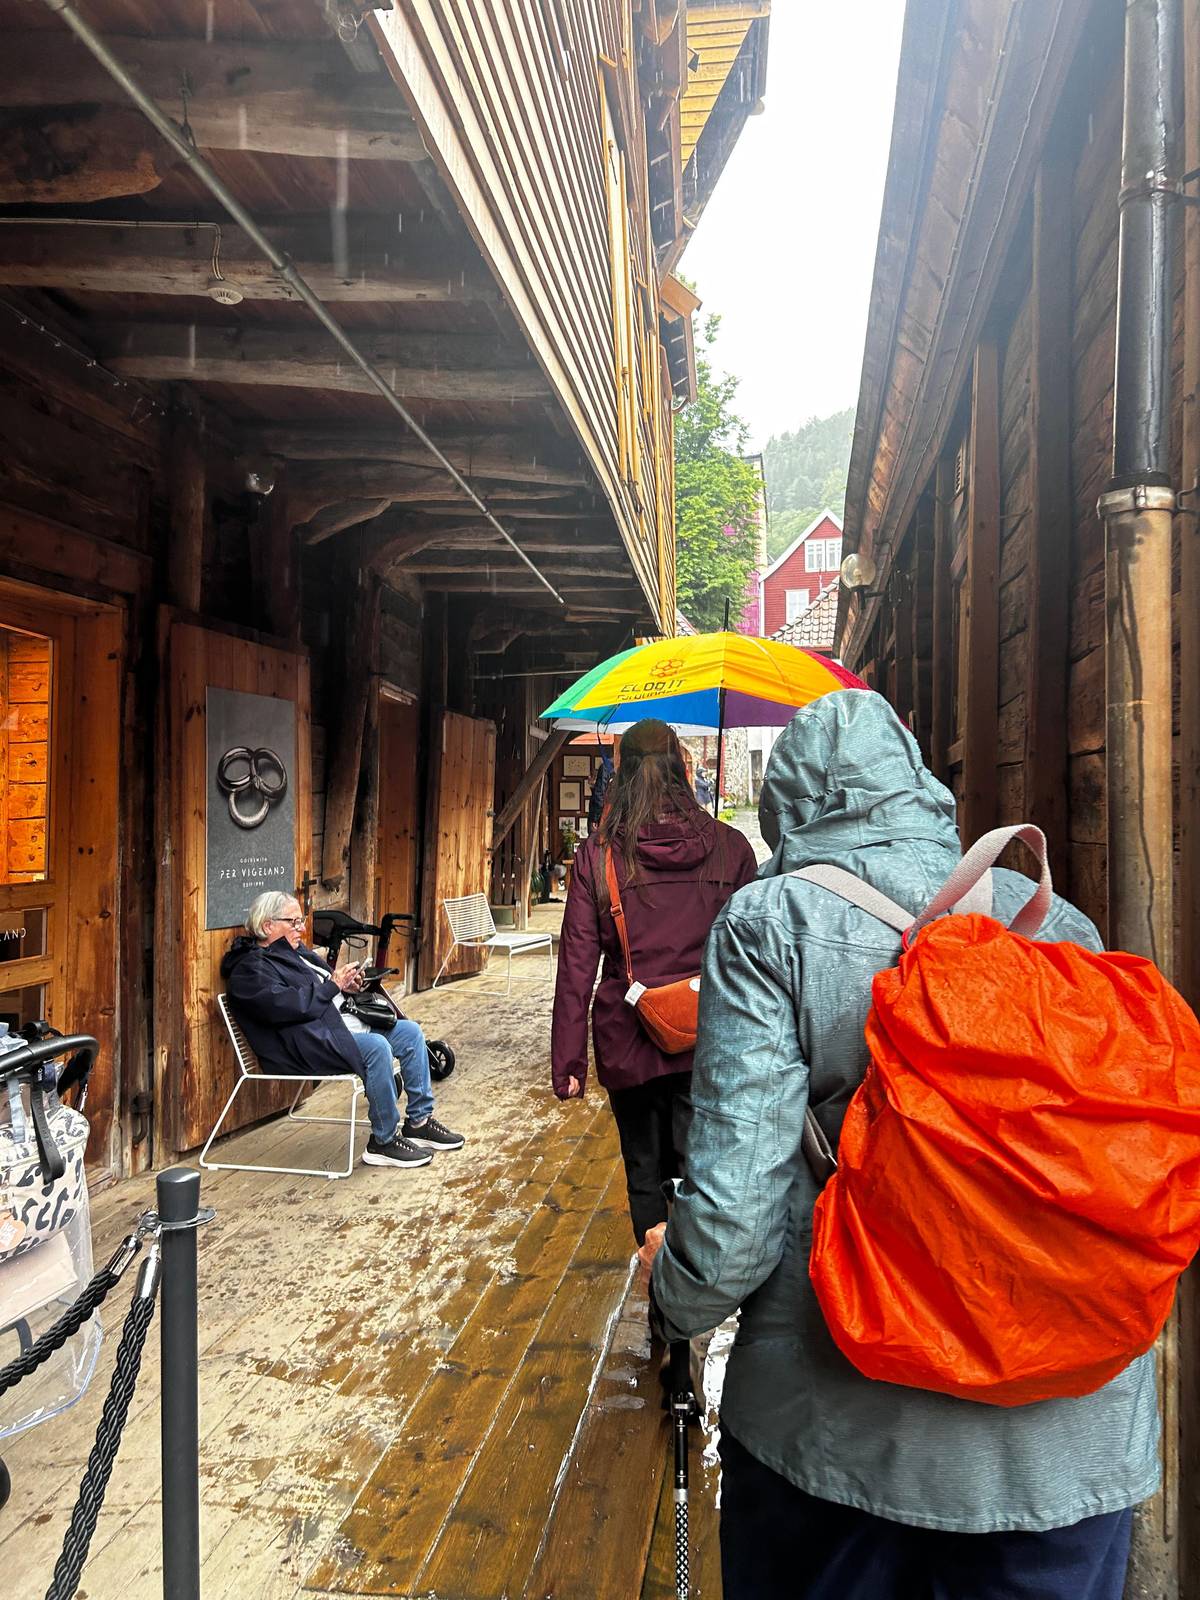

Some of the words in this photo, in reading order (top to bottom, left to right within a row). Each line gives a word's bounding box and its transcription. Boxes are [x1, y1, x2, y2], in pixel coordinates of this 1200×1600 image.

[220, 869, 236, 878] PER
[241, 866, 285, 877] VIGELAND
[0, 927, 26, 941] AND
